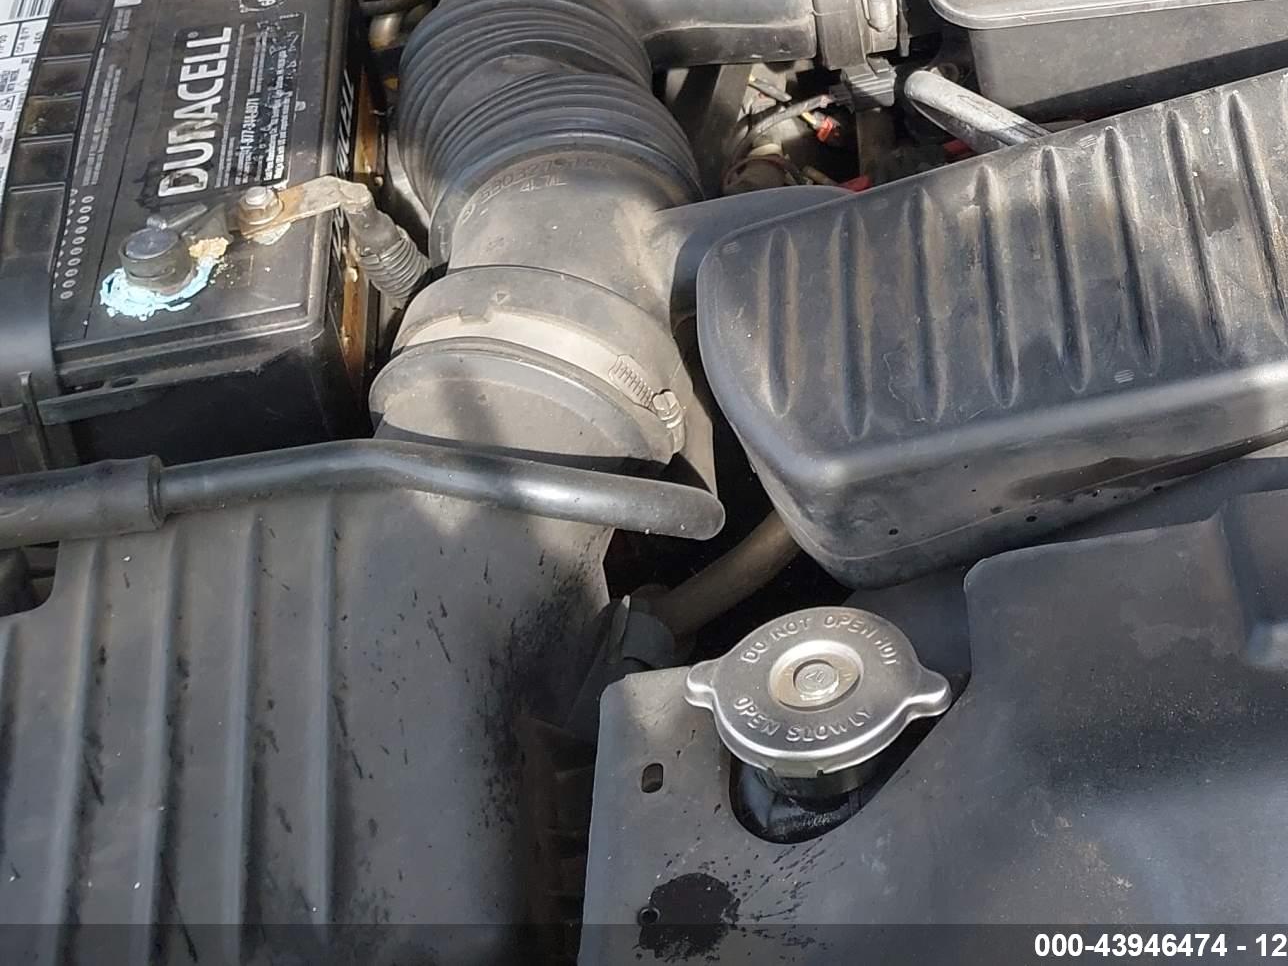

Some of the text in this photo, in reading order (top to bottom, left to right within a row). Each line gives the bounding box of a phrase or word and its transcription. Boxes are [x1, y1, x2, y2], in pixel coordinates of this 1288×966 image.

[158, 27, 233, 197] DURACELL
[741, 641, 768, 663] DO
[769, 617, 811, 641] NOT
[823, 615, 879, 640] OPEN
[733, 696, 873, 742] OPEN SLOWLY
